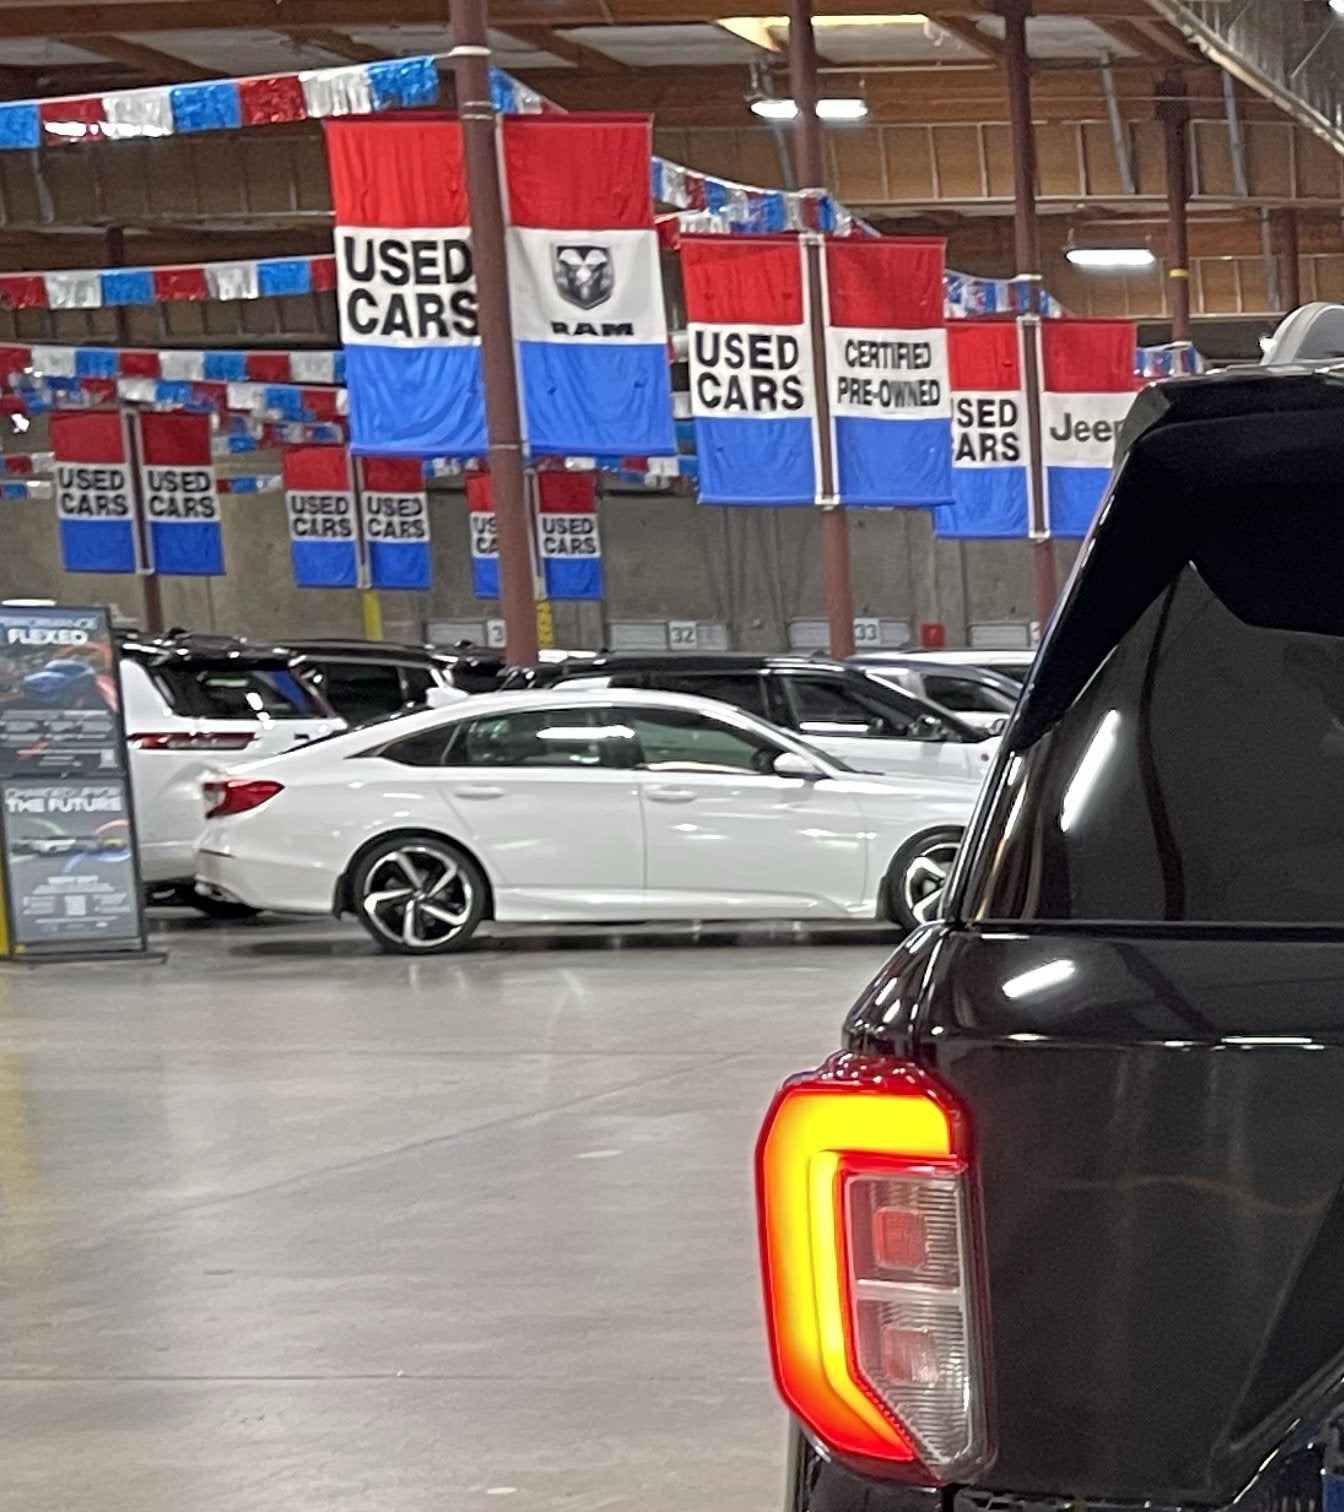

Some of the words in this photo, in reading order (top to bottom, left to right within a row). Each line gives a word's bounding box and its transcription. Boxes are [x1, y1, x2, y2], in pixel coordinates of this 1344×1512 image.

[344, 236, 472, 286] USED
[349, 288, 478, 338] CARS
[551, 321, 634, 336] RAM
[695, 331, 799, 370] USED
[845, 338, 932, 369] CERTIFIED
[697, 372, 804, 411] CARS
[837, 376, 941, 407] PRE-OWNED
[951, 398, 1018, 428] SED
[951, 432, 1020, 462] ARS
[58, 468, 125, 491] USED
[148, 470, 211, 493] USED
[60, 493, 129, 516] CARS
[149, 495, 215, 518] CARS
[291, 496, 349, 515] USED
[367, 496, 423, 516] USED
[292, 517, 352, 537] CARS
[367, 518, 425, 538] CARS
[473, 517, 497, 534] US
[542, 517, 594, 535] USED
[476, 537, 499, 554] CA
[543, 537, 596, 554] CARS
[671, 626, 695, 644] 32
